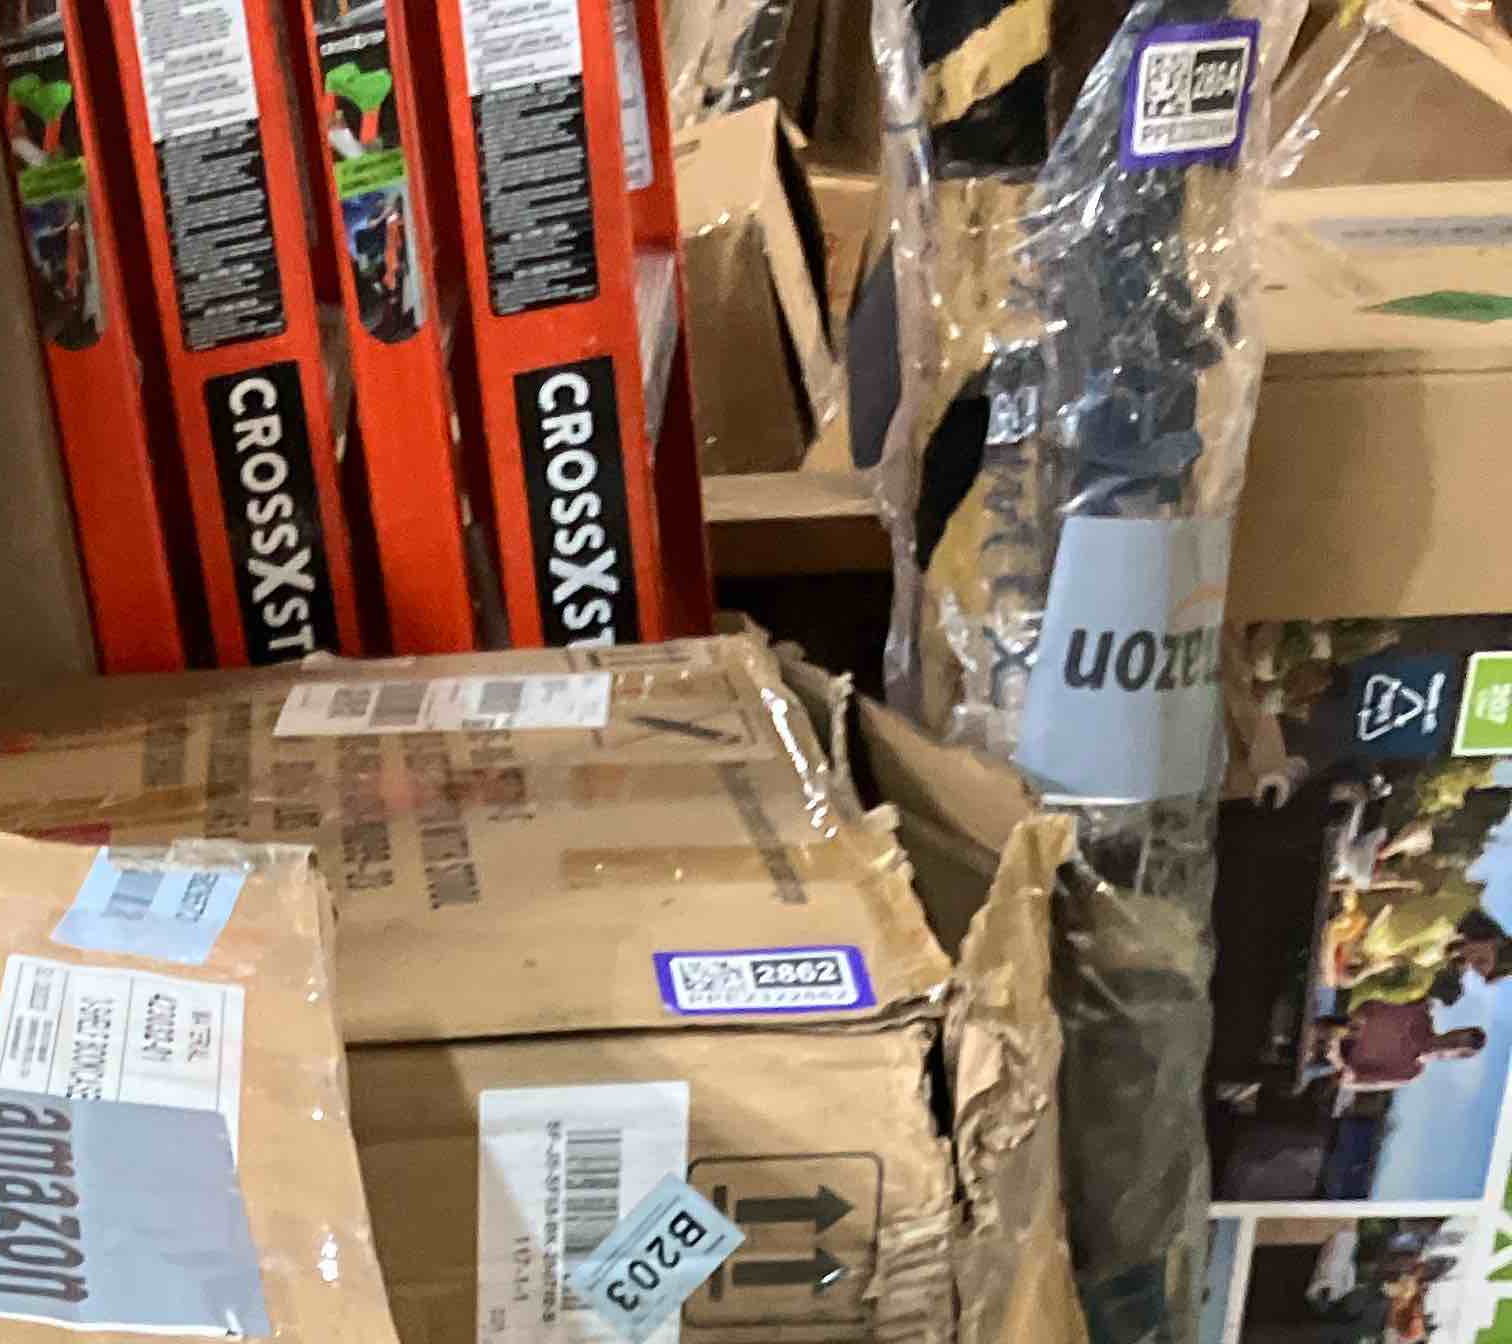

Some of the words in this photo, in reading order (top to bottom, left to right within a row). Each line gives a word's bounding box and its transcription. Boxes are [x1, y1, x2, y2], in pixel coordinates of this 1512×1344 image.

[229, 377, 316, 651] CROSSXST
[538, 372, 621, 649] CROSSXST
[755, 960, 839, 985] 2862
[606, 1210, 708, 1312] B203
